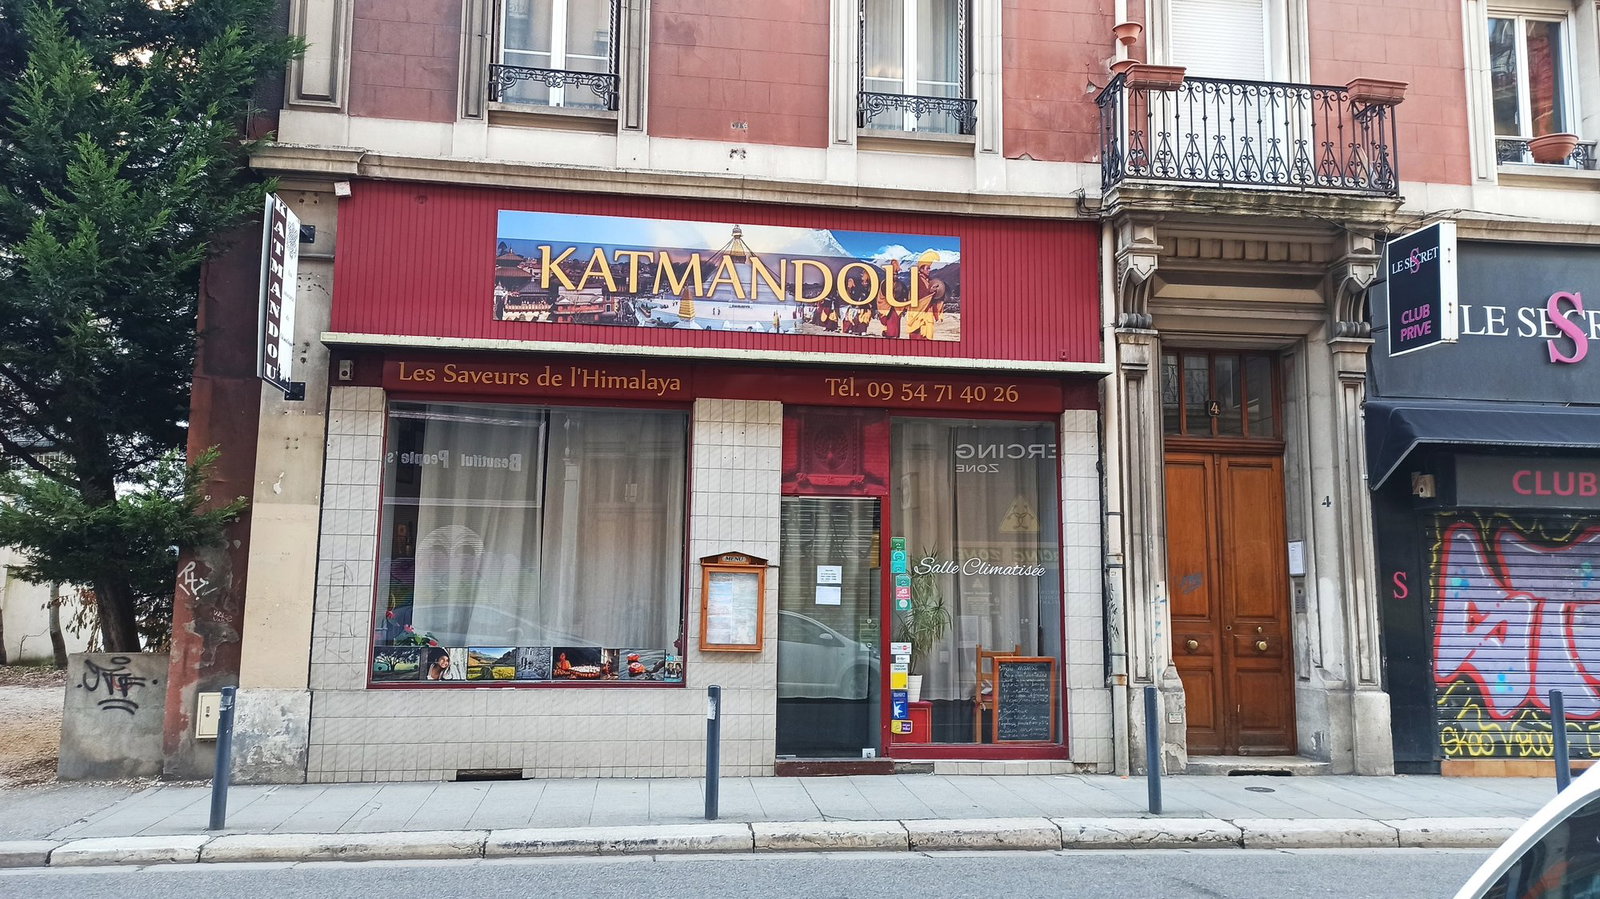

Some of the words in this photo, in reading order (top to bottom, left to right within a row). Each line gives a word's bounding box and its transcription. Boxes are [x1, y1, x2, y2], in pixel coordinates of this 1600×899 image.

[537, 245, 920, 308] KATMANDOU
[1392, 260, 1404, 275] LE
[265, 197, 287, 380] KATMANDOU
[1401, 303, 1430, 325] CLUB
[1459, 304, 1510, 336] LE
[1400, 320, 1432, 342] PRIVE
[398, 361, 436, 383] Les
[443, 363, 530, 387] Saveurs
[536, 365, 563, 388] de
[570, 366, 681, 396] l'Himalaya
[824, 376, 860, 398] Tél.
[867, 381, 894, 401] 09
[900, 383, 928, 402] 54
[934, 384, 953, 402] 71
[959, 384, 987, 403] 40
[993, 384, 1019, 403] 26
[1210, 402, 1220, 415] 4
[1512, 469, 1598, 497] CLUB
[1321, 495, 1332, 508] 4
[913, 557, 960, 576] Salle
[962, 557, 1046, 577] Climatisée
[1392, 571, 1409, 600] S
